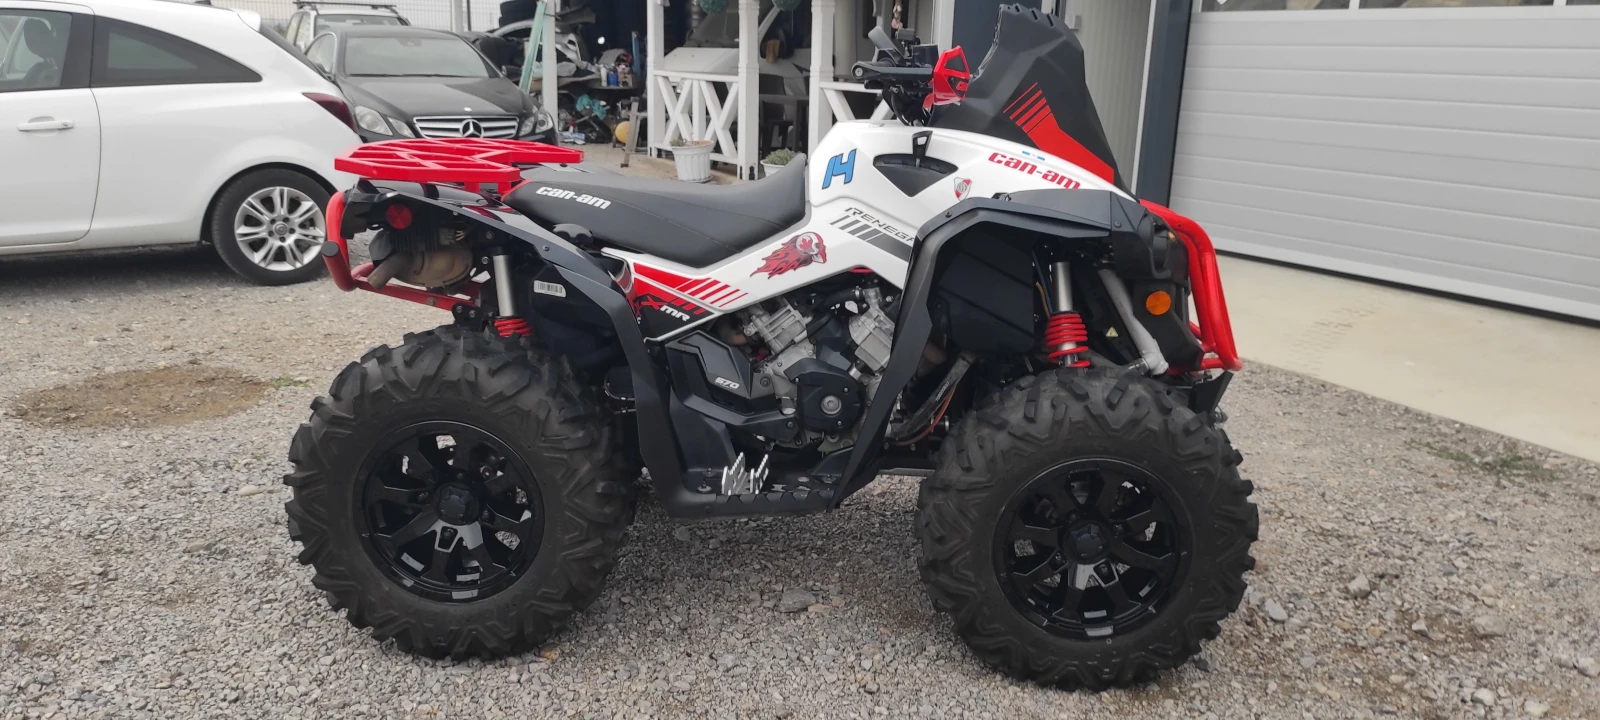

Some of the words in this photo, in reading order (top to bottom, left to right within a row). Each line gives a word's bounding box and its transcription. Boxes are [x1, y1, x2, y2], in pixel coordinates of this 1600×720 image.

[822, 148, 857, 190] 14
[988, 152, 1081, 189] can-am
[535, 186, 611, 210] can-am
